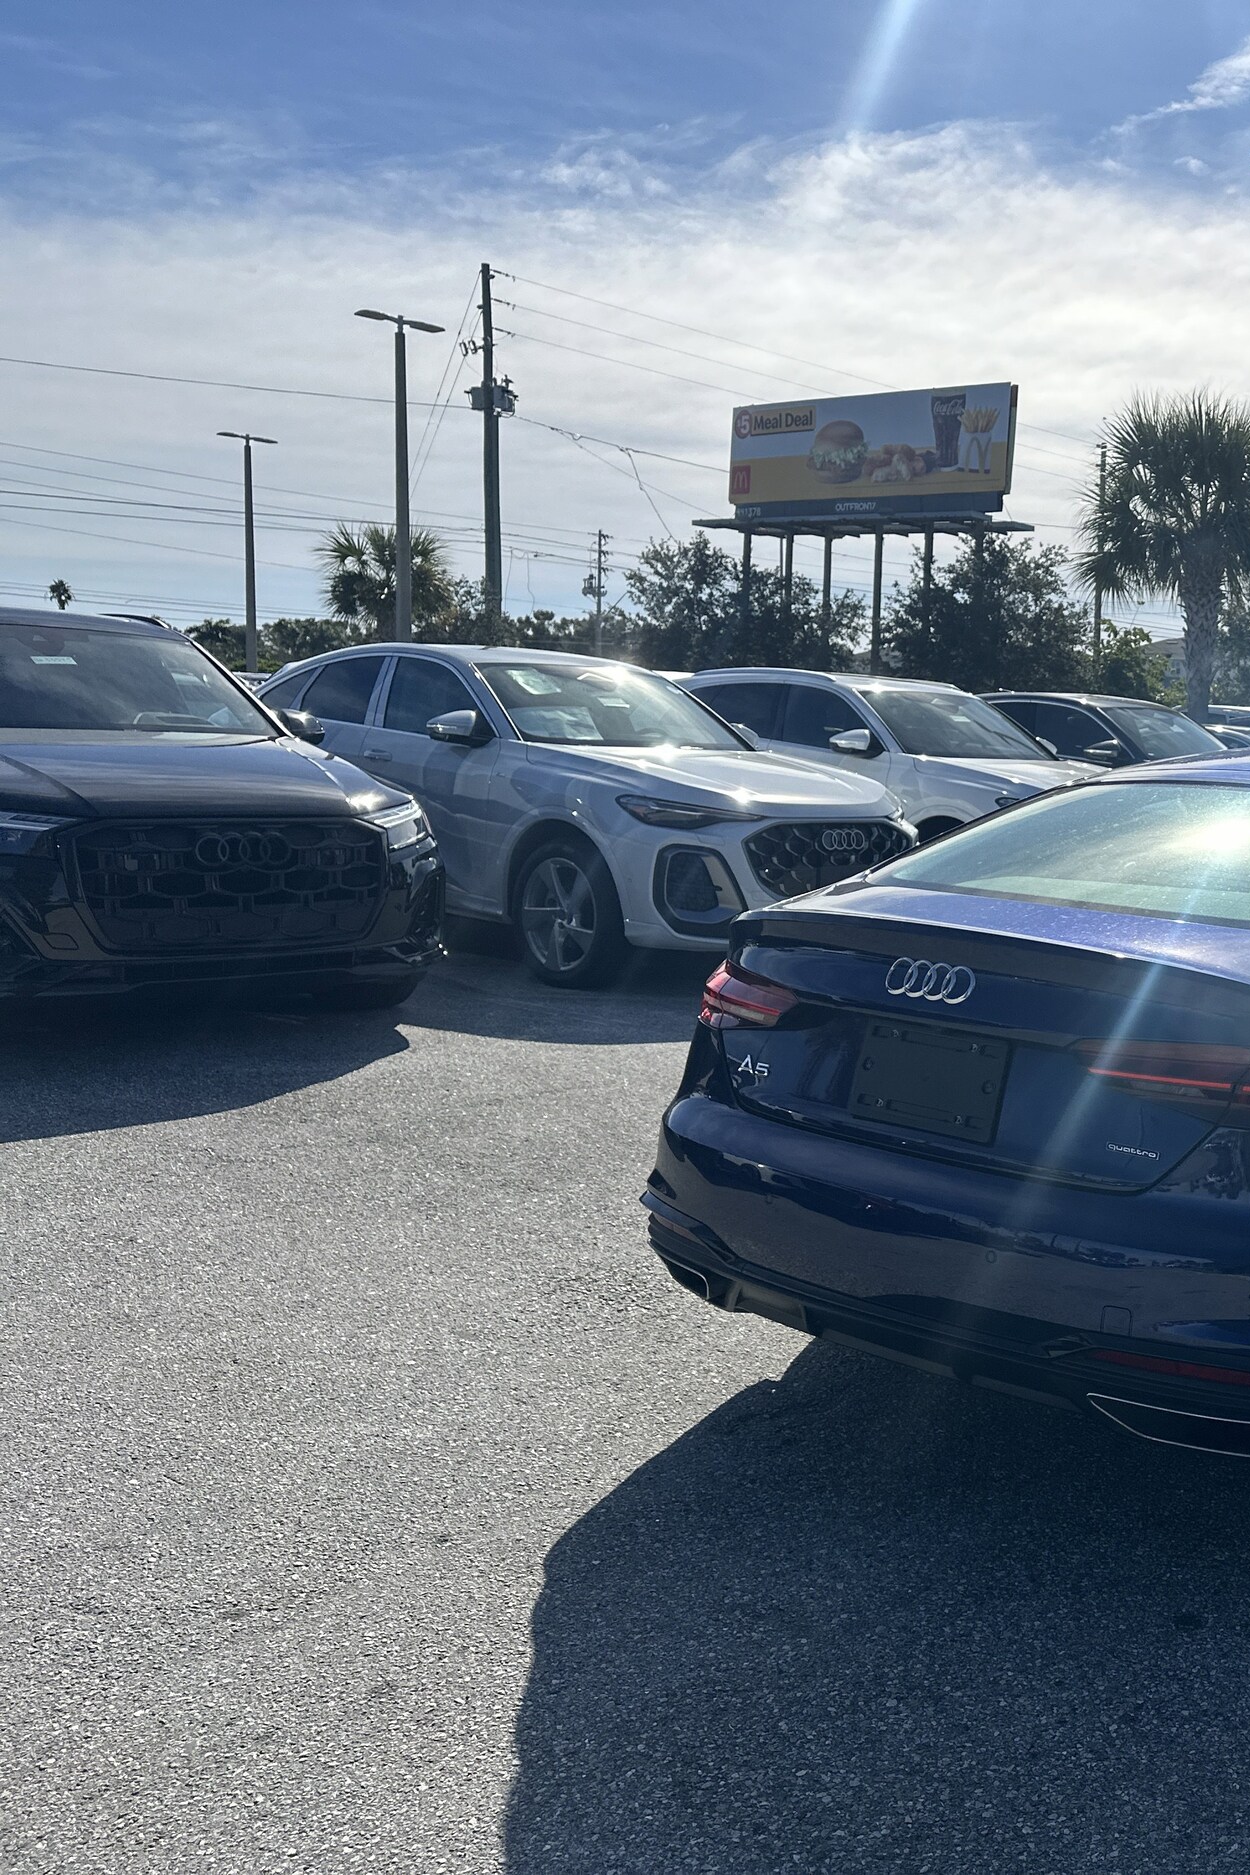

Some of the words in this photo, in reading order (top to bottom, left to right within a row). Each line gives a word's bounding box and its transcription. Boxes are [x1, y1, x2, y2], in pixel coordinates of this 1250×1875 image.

[753, 413, 782, 430] Meal
[785, 410, 813, 427] Deal
[737, 1054, 770, 1077] A5
[1108, 1143, 1157, 1158] quattro
